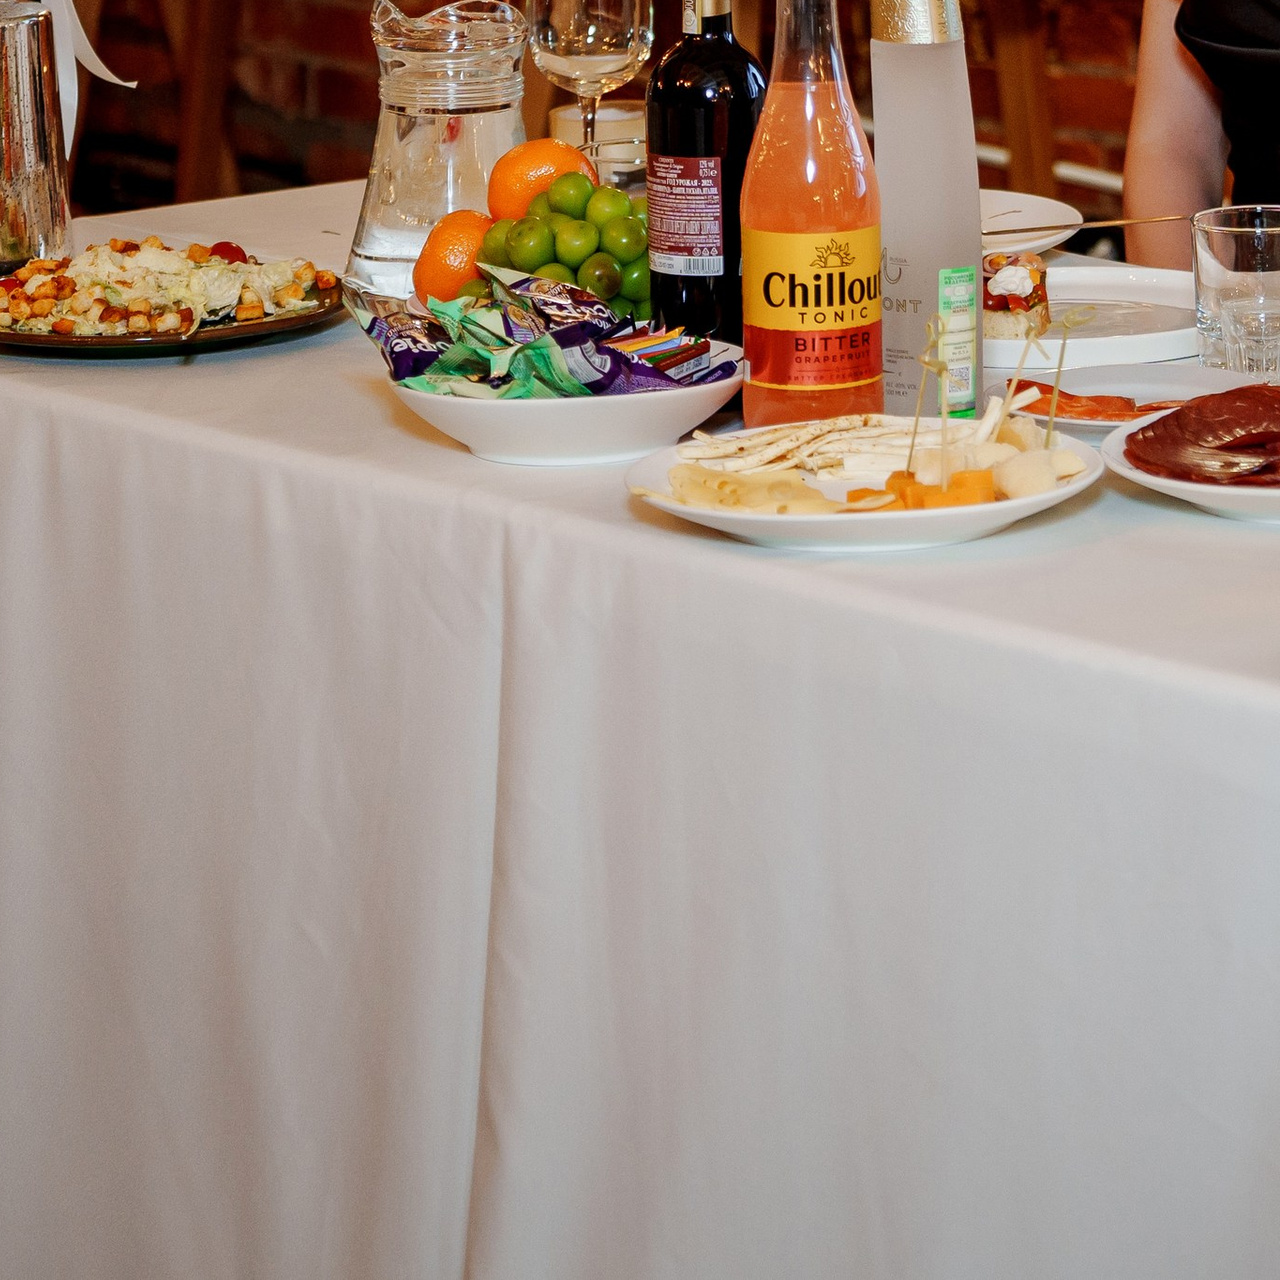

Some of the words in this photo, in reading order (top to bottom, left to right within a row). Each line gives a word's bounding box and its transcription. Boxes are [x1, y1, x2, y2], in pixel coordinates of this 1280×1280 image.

[882, 296, 922, 314] ONT
[798, 307, 868, 324] TONIC
[795, 332, 870, 352] BITTER
[795, 350, 870, 364] GRAPEFRUIT
